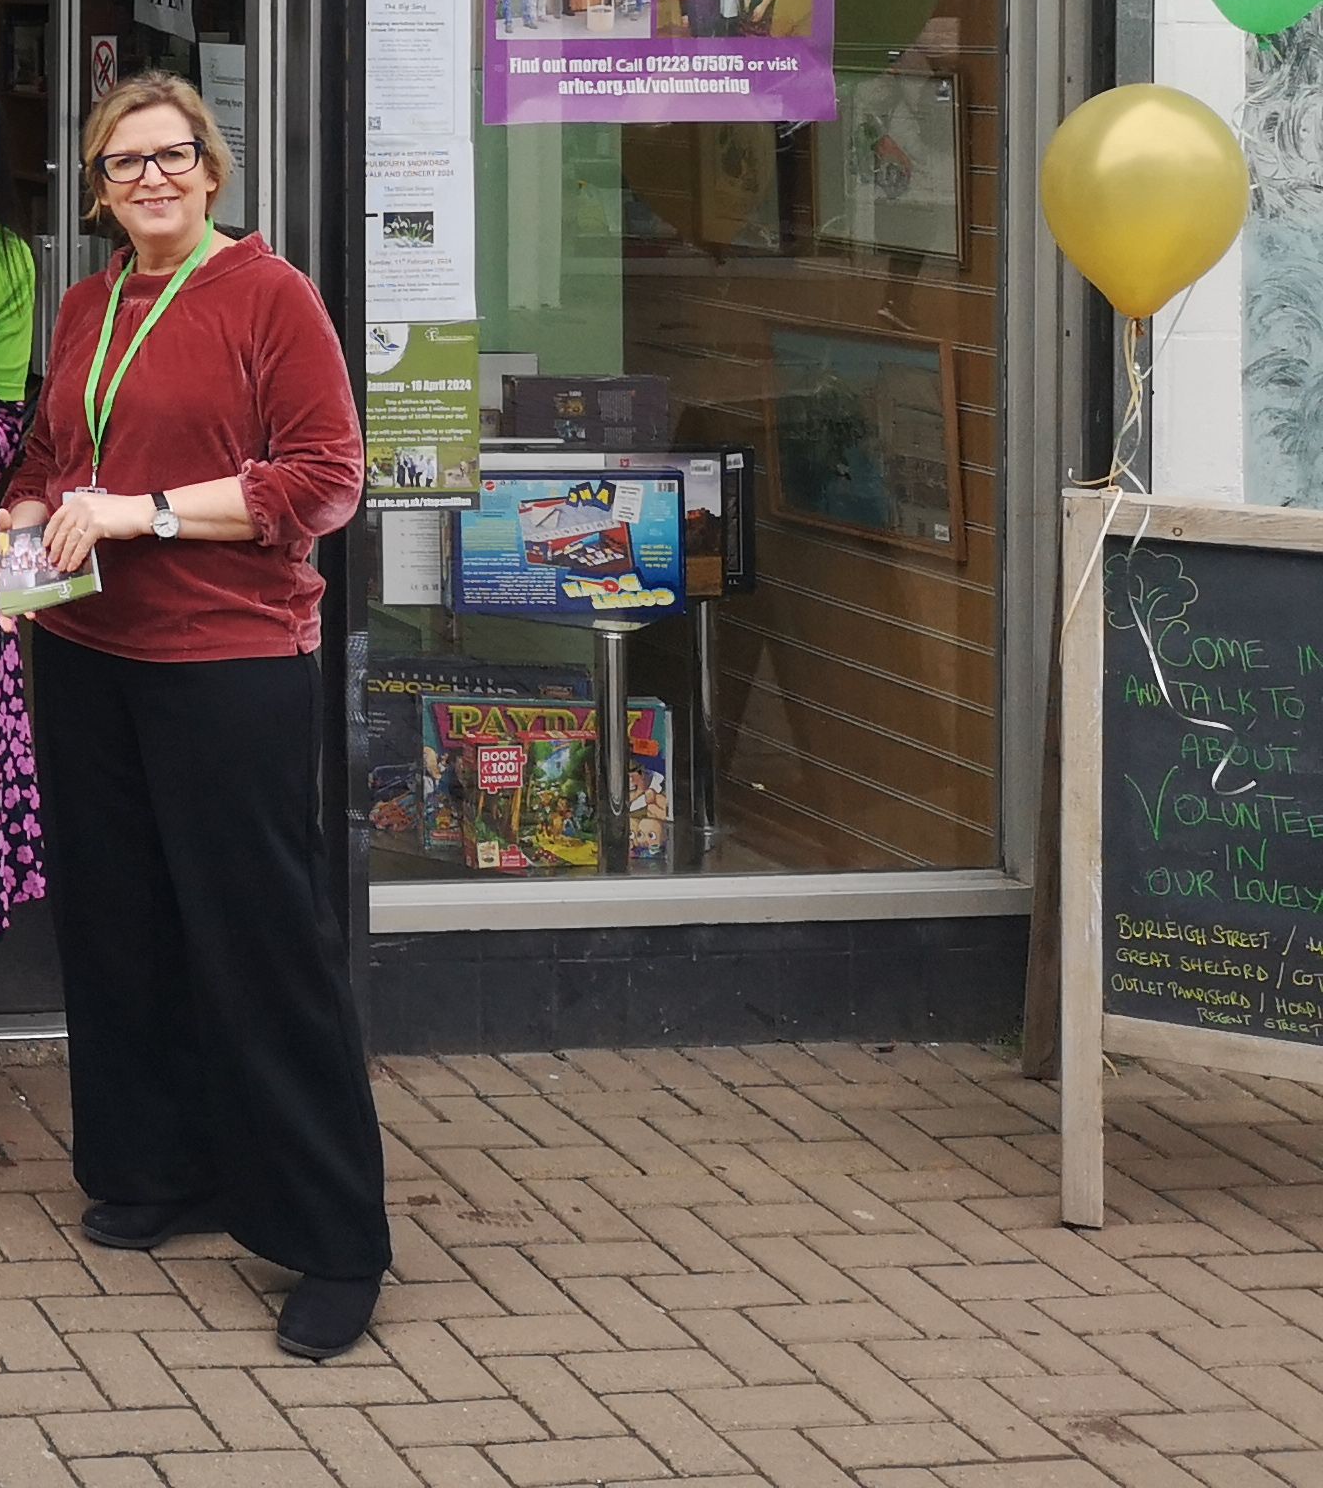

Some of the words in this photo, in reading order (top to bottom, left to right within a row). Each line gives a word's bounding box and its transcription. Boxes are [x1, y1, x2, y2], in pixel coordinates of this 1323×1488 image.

[510, 56, 539, 73] Find
[542, 56, 566, 72] out
[569, 56, 613, 74] more!
[616, 57, 643, 72] Call
[646, 55, 690, 73] 01223
[693, 55, 744, 73] 675875
[747, 60, 765, 72] or
[767, 57, 799, 72] visit
[559, 76, 750, 97] arhc.org.uk/volunteering
[1157, 619, 1269, 672] COME
[1125, 673, 1161, 707] AND
[1168, 679, 1259, 716] TALK
[1261, 685, 1305, 720] TO
[481, 751, 518, 762] BOOK
[491, 762, 515, 774] 100
[1180, 732, 1298, 775] ABOUT
[481, 775, 518, 785] JIGSAW
[1225, 837, 1267, 872] IN
[1147, 866, 1223, 903] OUR
[1234, 875, 1323, 913] LOVELY
[1115, 912, 1206, 946] BURLEIGH
[1210, 924, 1271, 950] STREET
[1116, 947, 1171, 968] GREAT
[1179, 956, 1269, 982] SHELFORD
[1111, 973, 1165, 997] OUTLET
